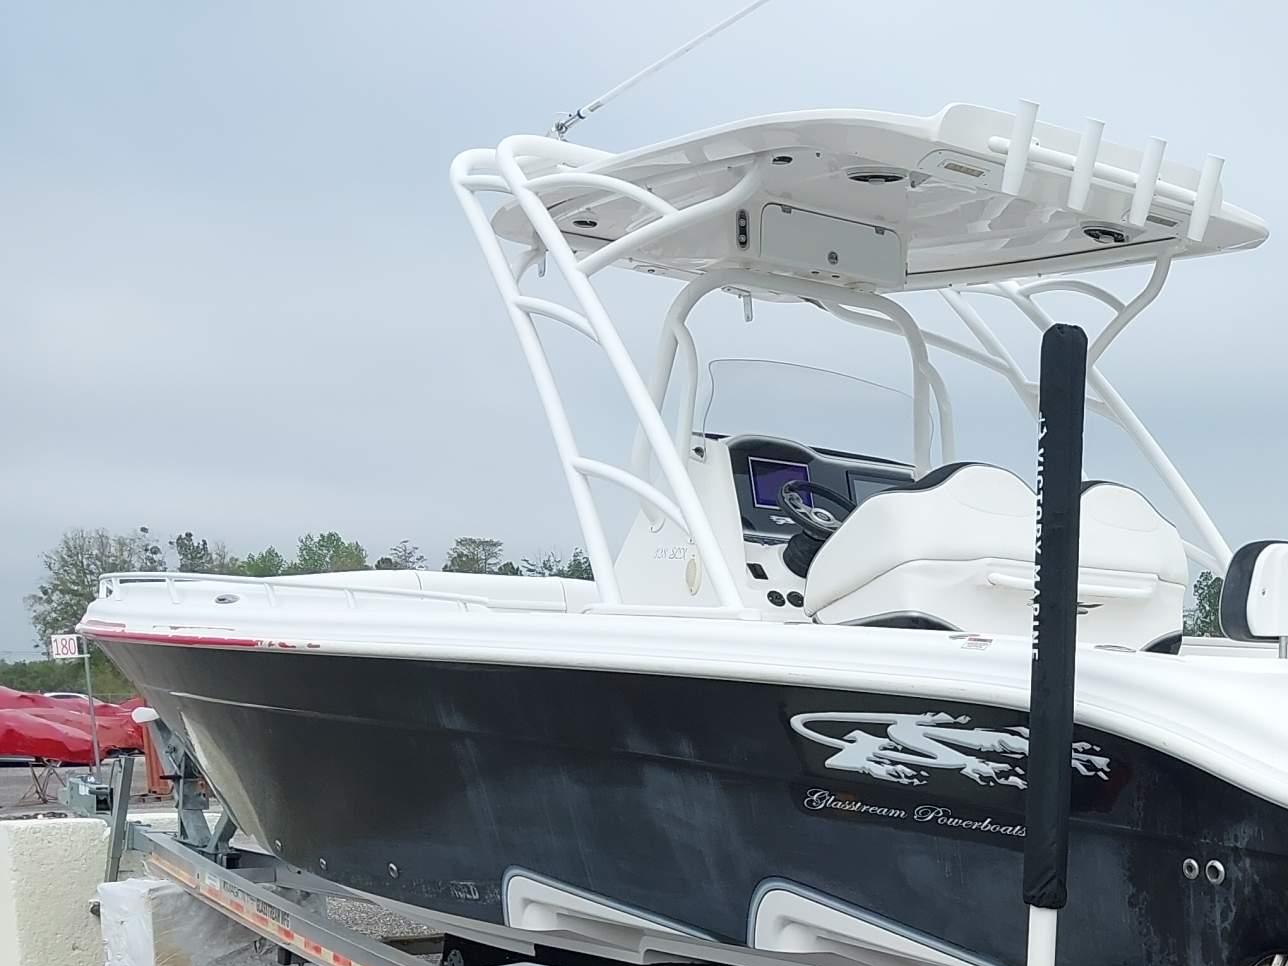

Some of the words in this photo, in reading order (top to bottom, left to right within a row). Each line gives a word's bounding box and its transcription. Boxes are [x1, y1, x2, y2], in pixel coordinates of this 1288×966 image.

[53, 637, 77, 656] 180
[803, 788, 908, 819] Glasstream
[913, 805, 1027, 838] Powerboats
